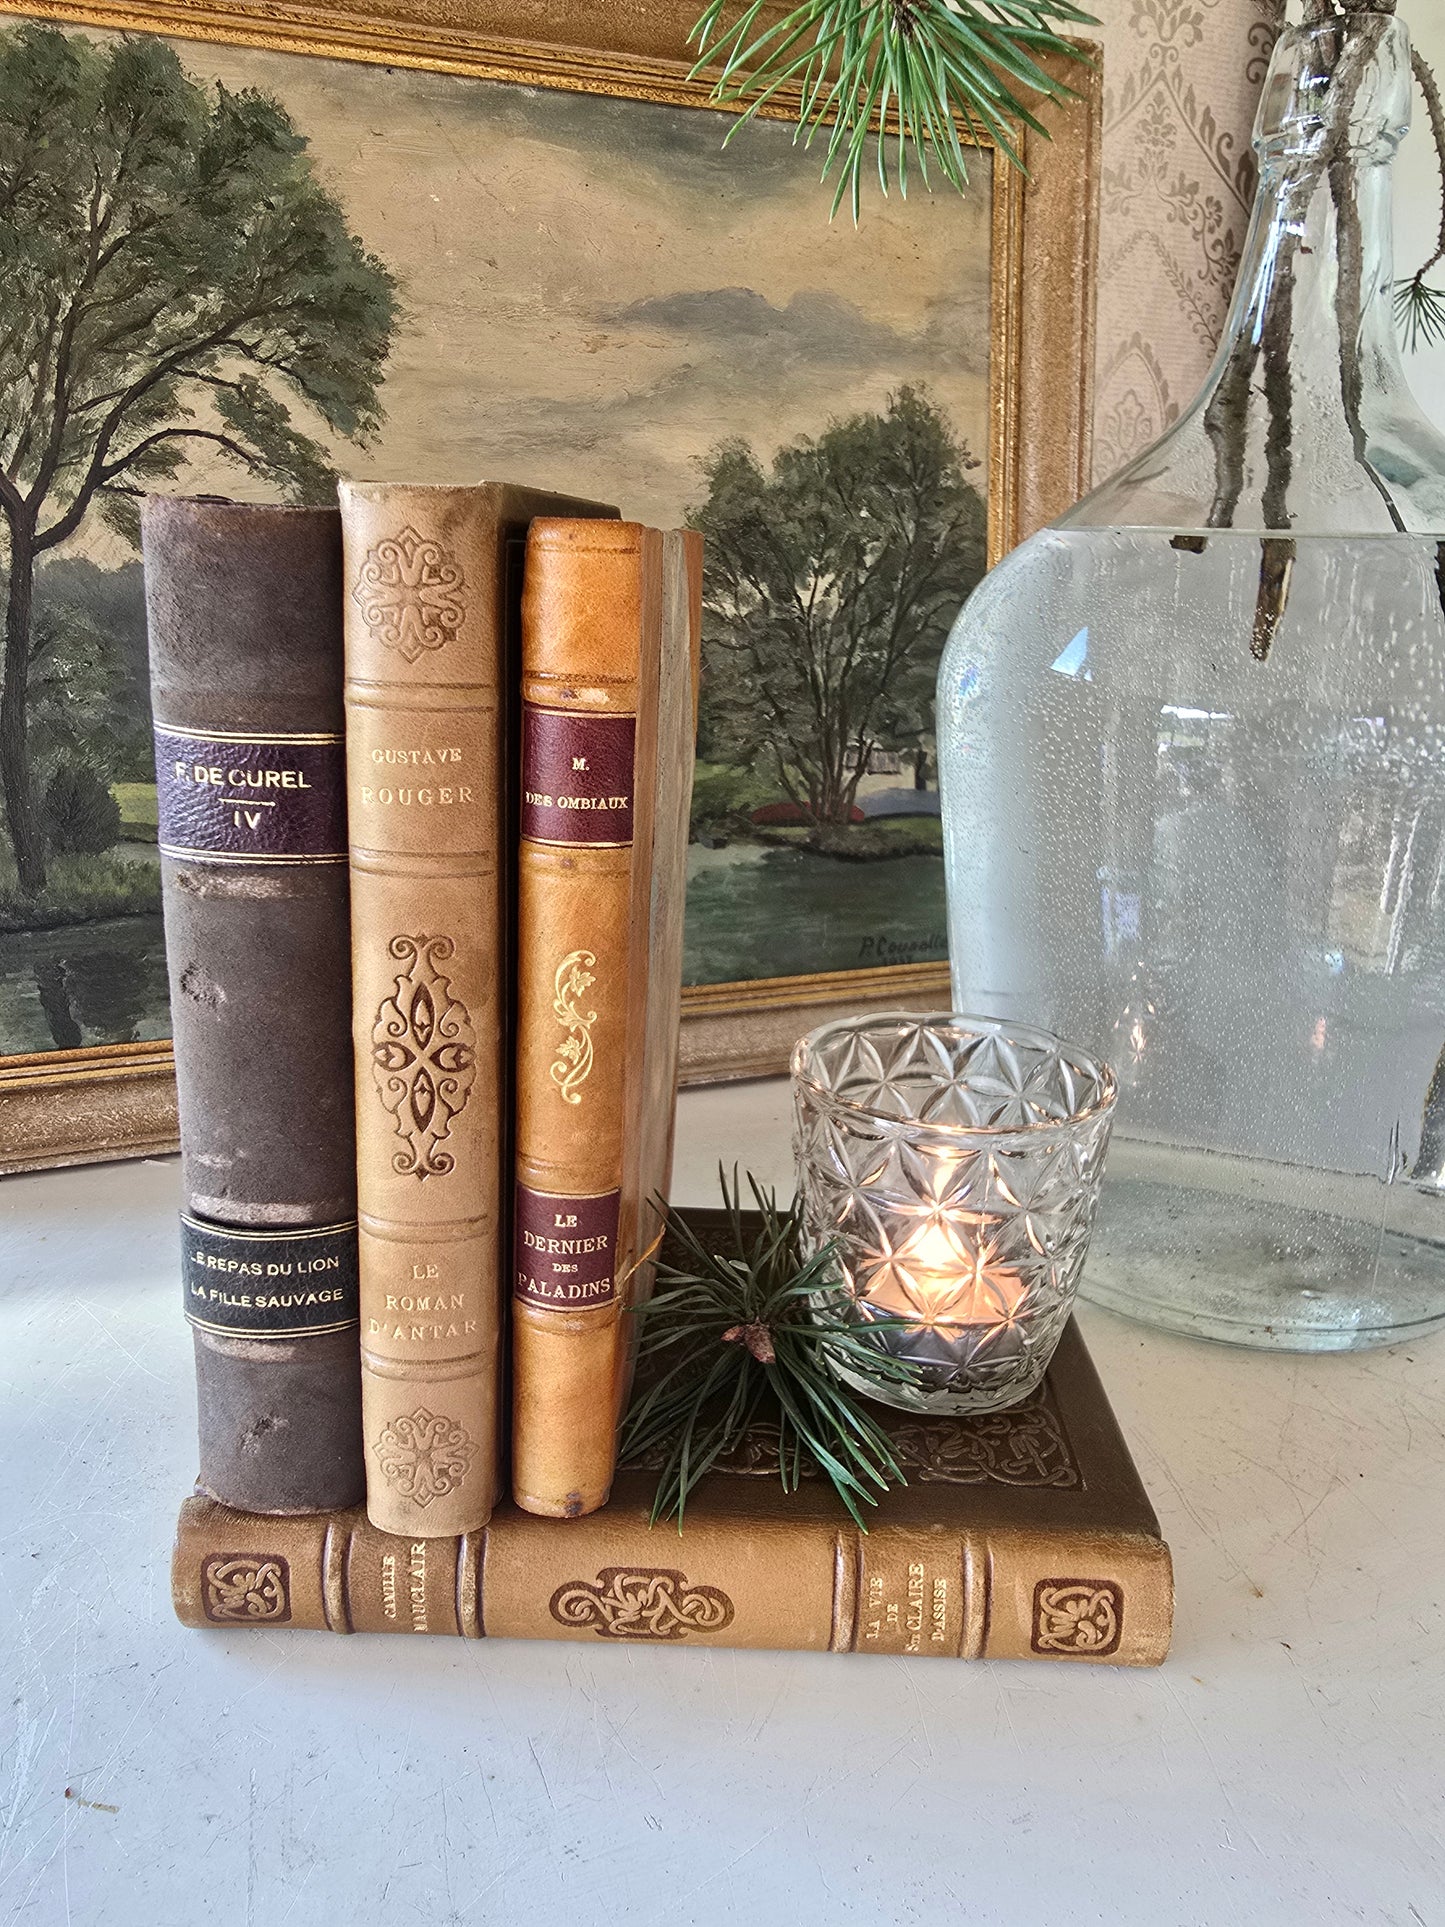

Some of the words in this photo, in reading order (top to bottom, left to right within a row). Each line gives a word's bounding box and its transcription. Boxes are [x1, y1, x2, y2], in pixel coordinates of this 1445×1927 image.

[371, 748, 462, 765] GUSTAVE
[572, 757, 590, 771] M.
[194, 765, 225, 786] DE
[228, 769, 312, 789] CUREL
[361, 786, 476, 806] ROUGER
[526, 791, 553, 807] DES
[557, 796, 629, 810] OMBIAUX
[233, 810, 262, 830] IV
[553, 1213, 578, 1228] LE
[524, 1230, 608, 1255] DERNIER
[207, 1255, 262, 1276] REPAS
[267, 1263, 292, 1276] DU
[297, 1256, 339, 1274] LION
[412, 1263, 439, 1280] LE
[552, 1262, 578, 1273] DES
[190, 1281, 207, 1300] LA
[209, 1288, 252, 1308] FILLE
[255, 1288, 344, 1308] SAUVAGE
[518, 1272, 611, 1299] PALADINS
[385, 1293, 465, 1311] ROMAN
[369, 1317, 477, 1341] D'ANTAR
[382, 1555, 397, 1619] CAMILLE
[869, 1577, 883, 1608] VIE
[906, 1563, 924, 1631] CLAIRE
[887, 1603, 899, 1623] DE
[866, 1620, 881, 1639] LA
